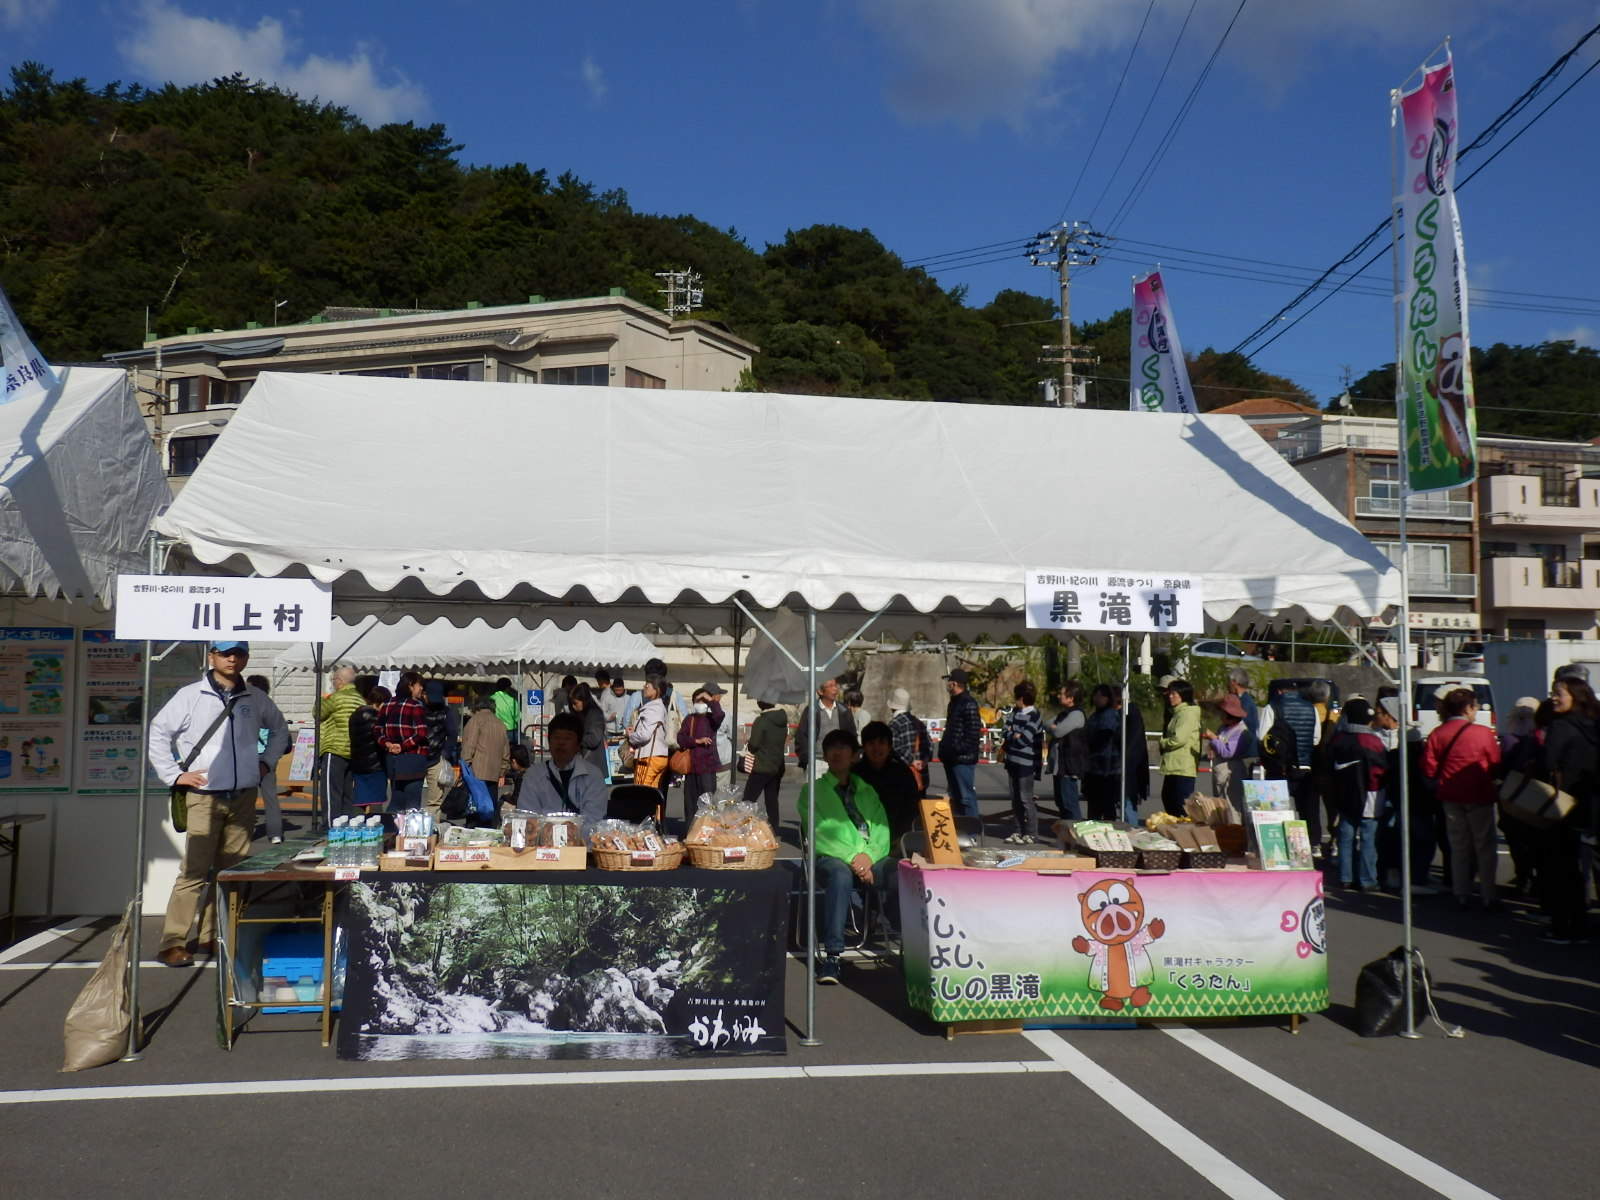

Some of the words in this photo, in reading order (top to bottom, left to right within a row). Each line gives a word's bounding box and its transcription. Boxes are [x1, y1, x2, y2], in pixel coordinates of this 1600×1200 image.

[1410, 198, 1438, 375] くろたん
[1141, 353, 1165, 412] くろ
[188, 586, 225, 594] 源流まつり
[1036, 575, 1099, 587] 吉野川・紀の川
[1107, 576, 1153, 588] 源流まつり
[1163, 579, 1192, 590] 奈良県
[192, 602, 303, 632] 川上村
[1050, 590, 1180, 627] 黒滝村
[930, 944, 985, 970] よし、
[1163, 956, 1255, 967] 黒滝村キャラクター
[1169, 971, 1250, 991] 「くろたん」
[688, 1008, 767, 1049] かわかみ
